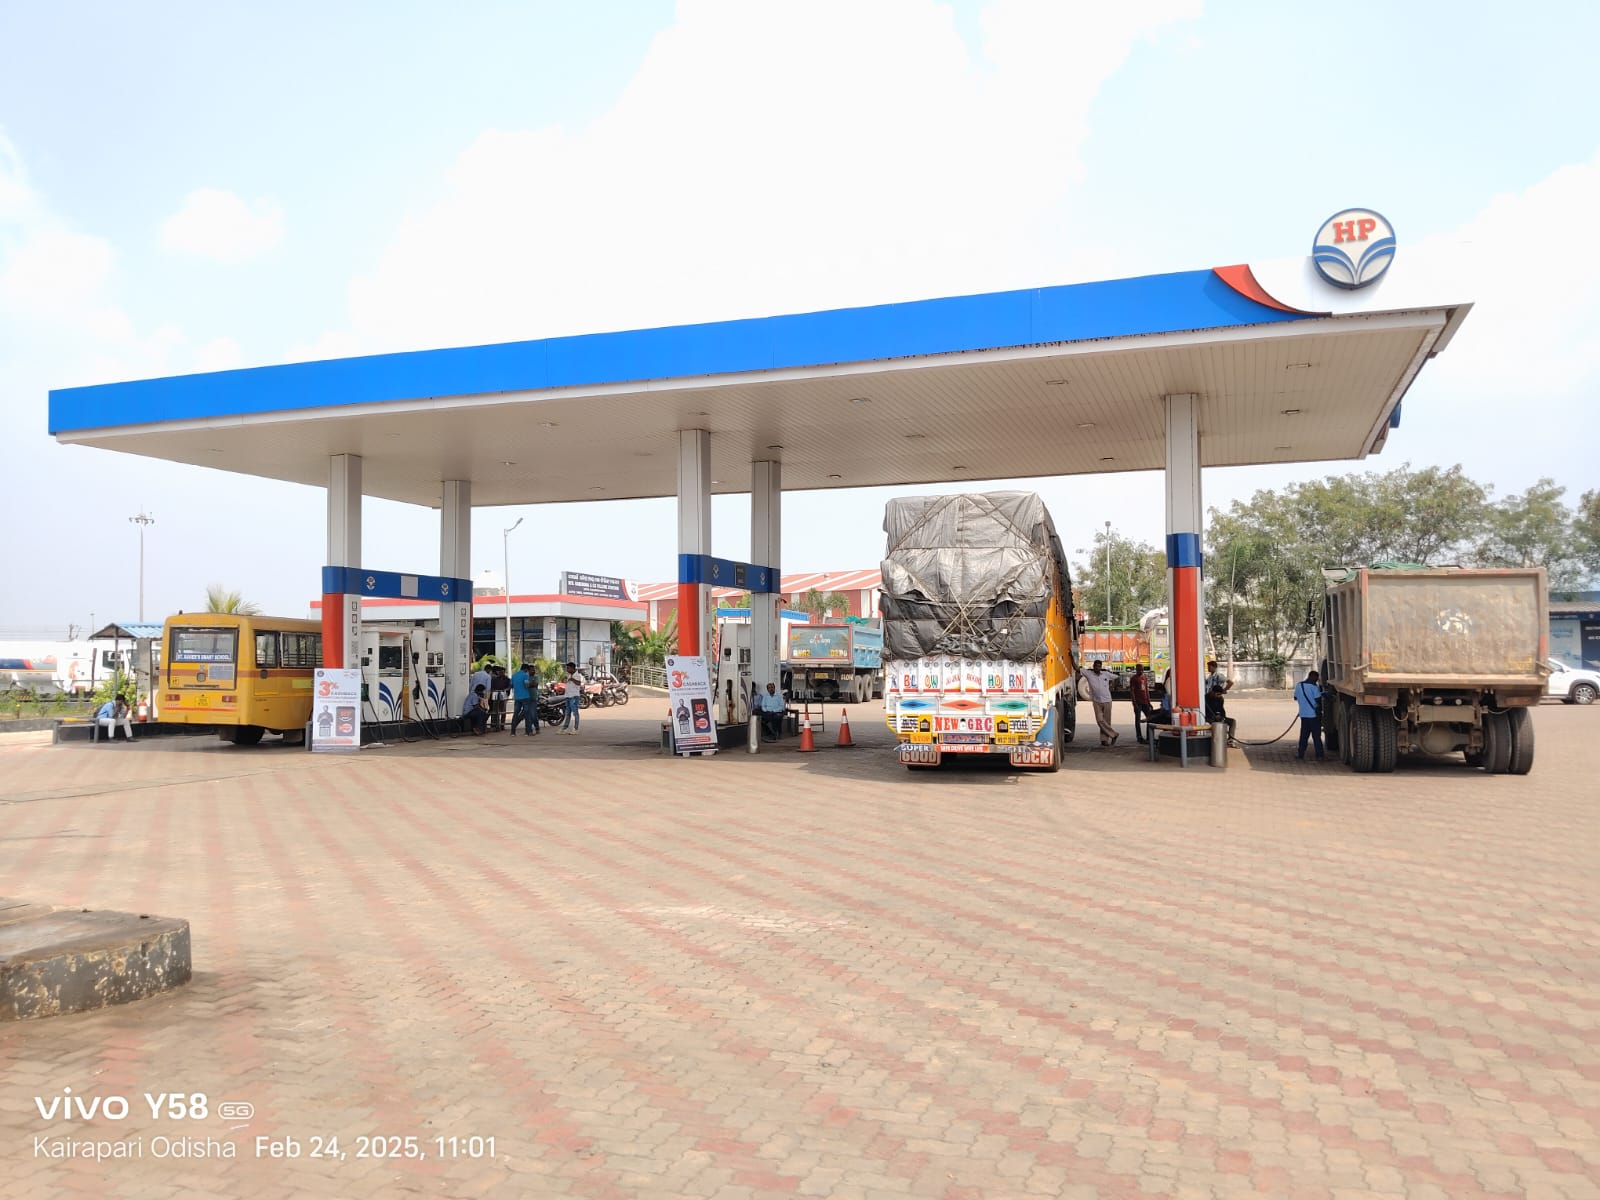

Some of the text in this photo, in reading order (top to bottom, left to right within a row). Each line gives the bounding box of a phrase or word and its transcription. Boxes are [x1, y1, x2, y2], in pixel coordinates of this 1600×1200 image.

[1333, 218, 1377, 244] HP
[935, 716, 959, 732] NEW
[967, 717, 993, 732] GRC
